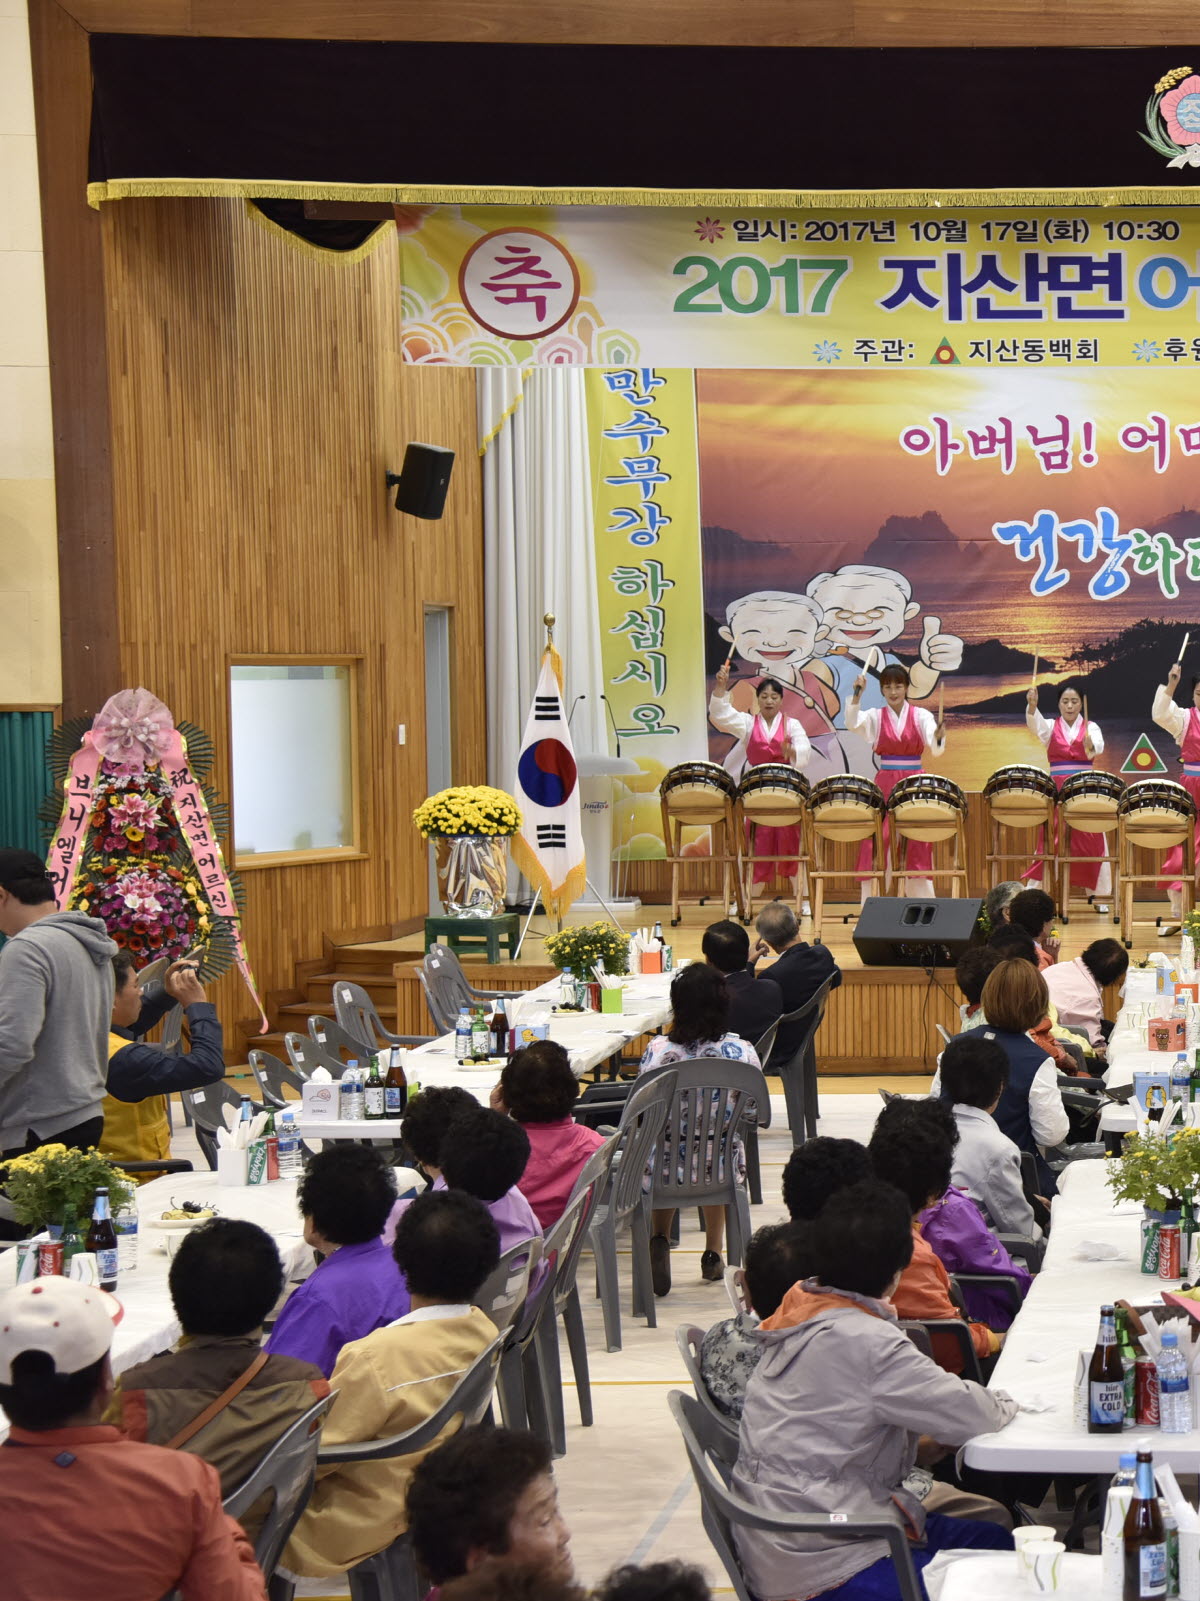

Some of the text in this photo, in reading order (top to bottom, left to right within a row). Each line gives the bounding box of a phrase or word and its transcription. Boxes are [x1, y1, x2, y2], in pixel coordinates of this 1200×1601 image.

[733, 217, 1180, 244] 일시: 2017년 10월 17일(화) 10:30
[480, 245, 563, 324] 축
[672, 255, 848, 314] 2017
[881, 251, 1126, 321] 지산면
[853, 337, 1100, 364] 주관: 지산동백회
[901, 414, 1098, 473] 아버님!
[603, 367, 681, 739] 만수무강 하십시오
[170, 767, 228, 909] 祝 지산면 어르신
[1099, 1392, 1123, 1402] EXTRA
[1101, 1402, 1122, 1411] COLD
